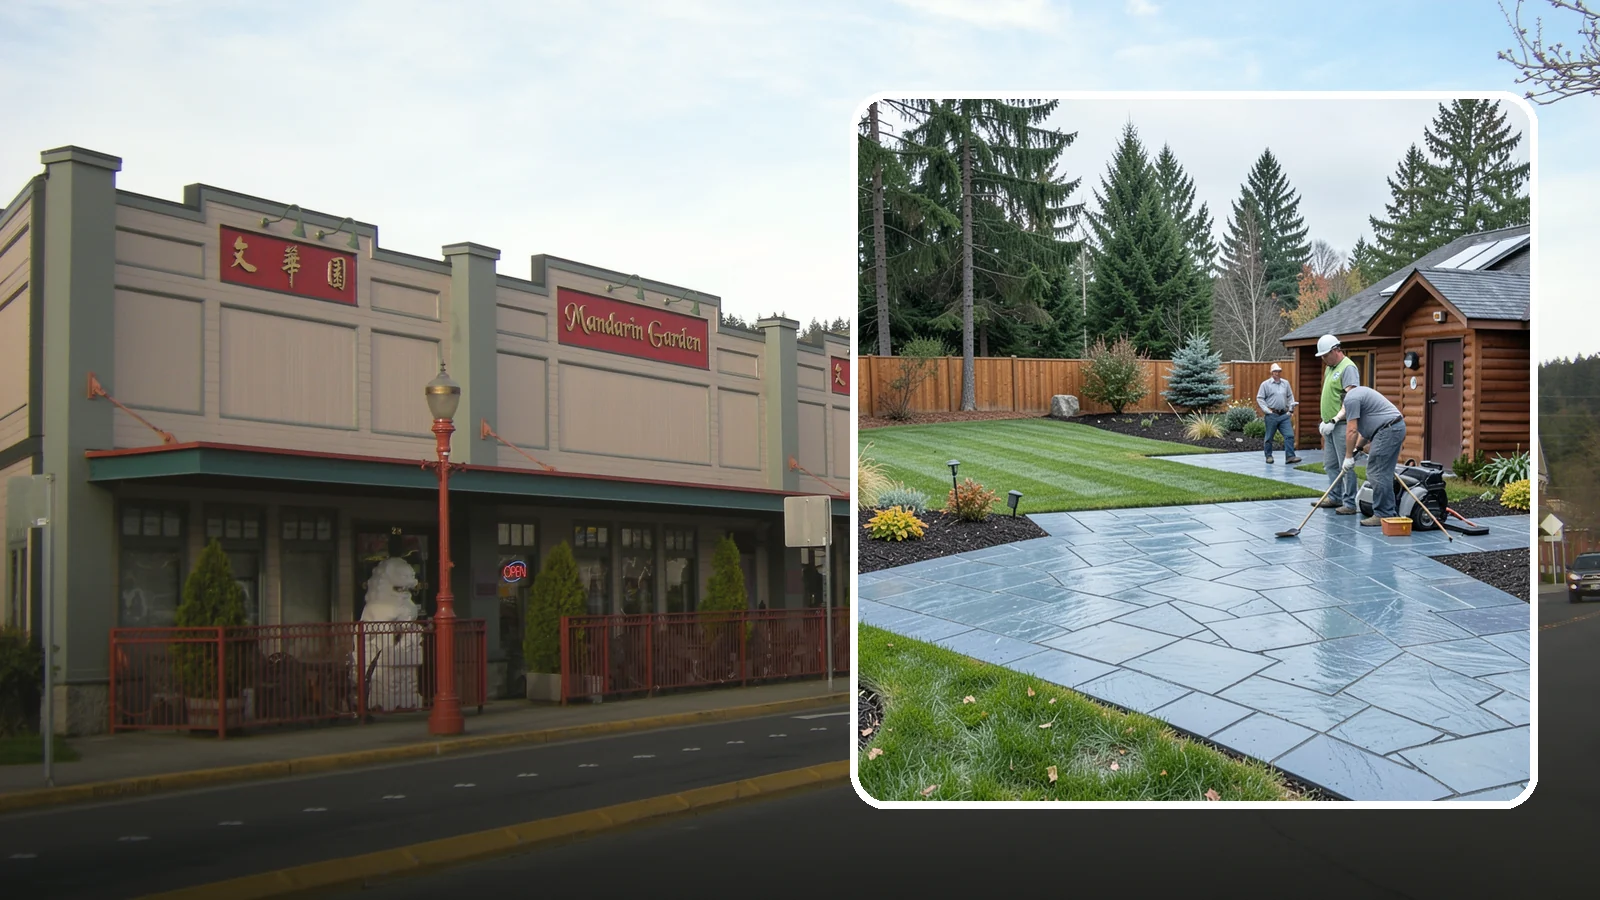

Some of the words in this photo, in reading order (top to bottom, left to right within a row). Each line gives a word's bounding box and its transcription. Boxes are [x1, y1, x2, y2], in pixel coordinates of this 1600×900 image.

[230, 236, 347, 291] 文華園
[564, 302, 644, 341] Mandarin
[648, 320, 702, 352] Garden
[503, 565, 527, 578] OPEN
